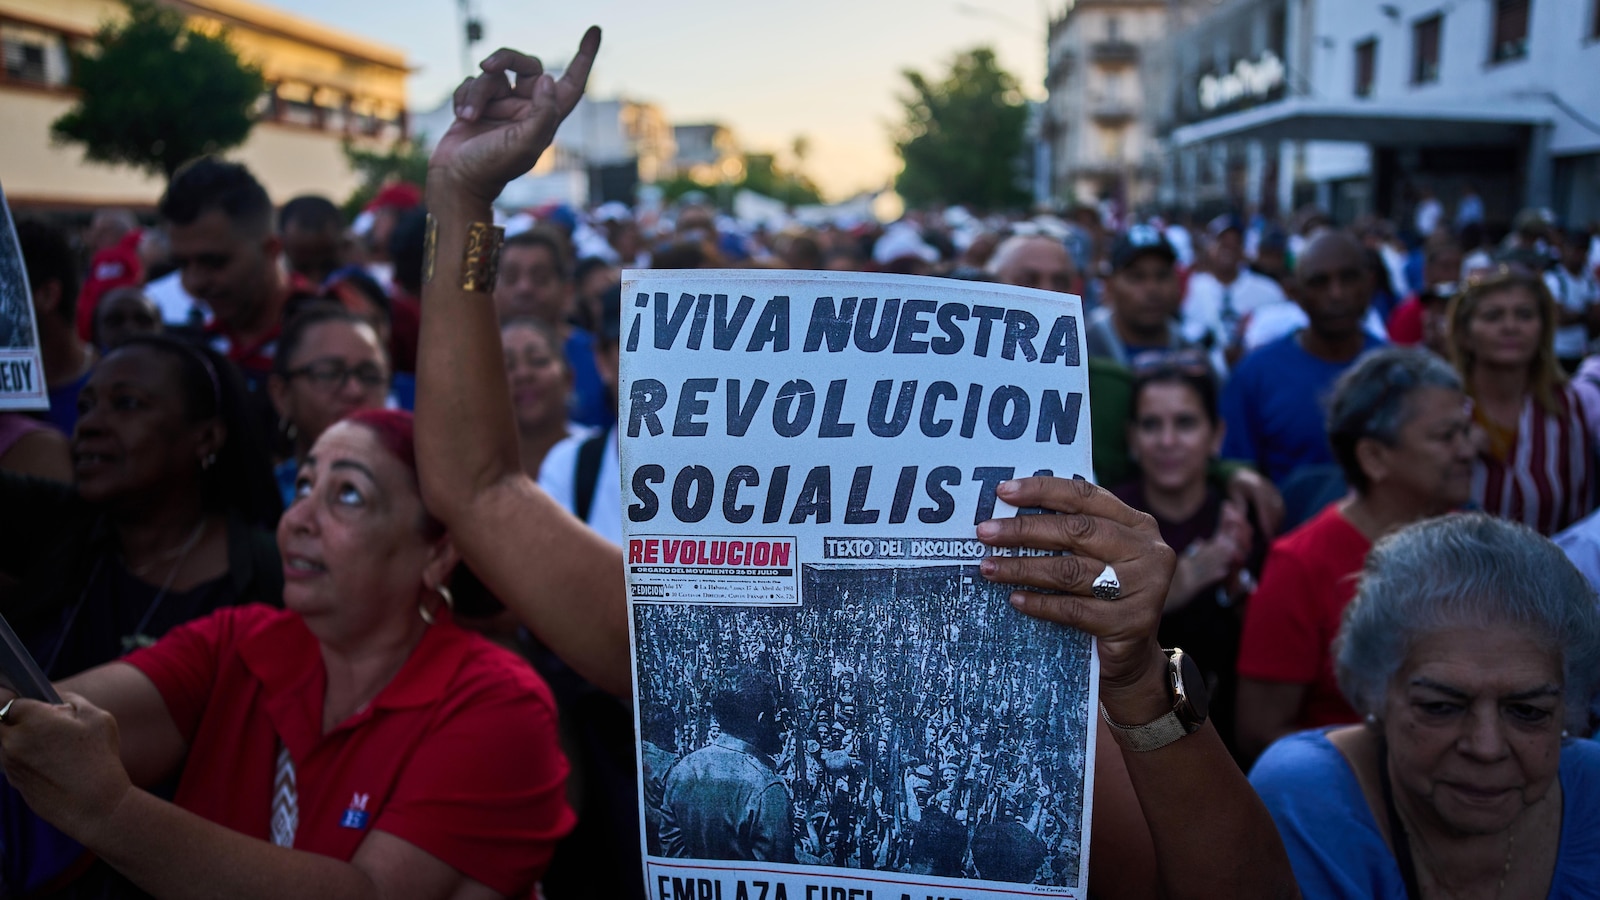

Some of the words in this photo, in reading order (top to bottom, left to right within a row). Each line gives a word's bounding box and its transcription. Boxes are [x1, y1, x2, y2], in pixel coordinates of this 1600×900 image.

[626, 292, 790, 352] ¡VIVA
[803, 296, 1081, 366] NUESTRA
[0, 361, 32, 391] EDY
[626, 378, 1083, 445] REVOLUCION
[628, 539, 791, 566] REVOLUCION
[826, 539, 874, 557] TEXTO
[879, 540, 904, 557] DEL
[911, 541, 986, 558] DISCURSO
[671, 567, 686, 575] DEL
[637, 585, 663, 596] EDICION
